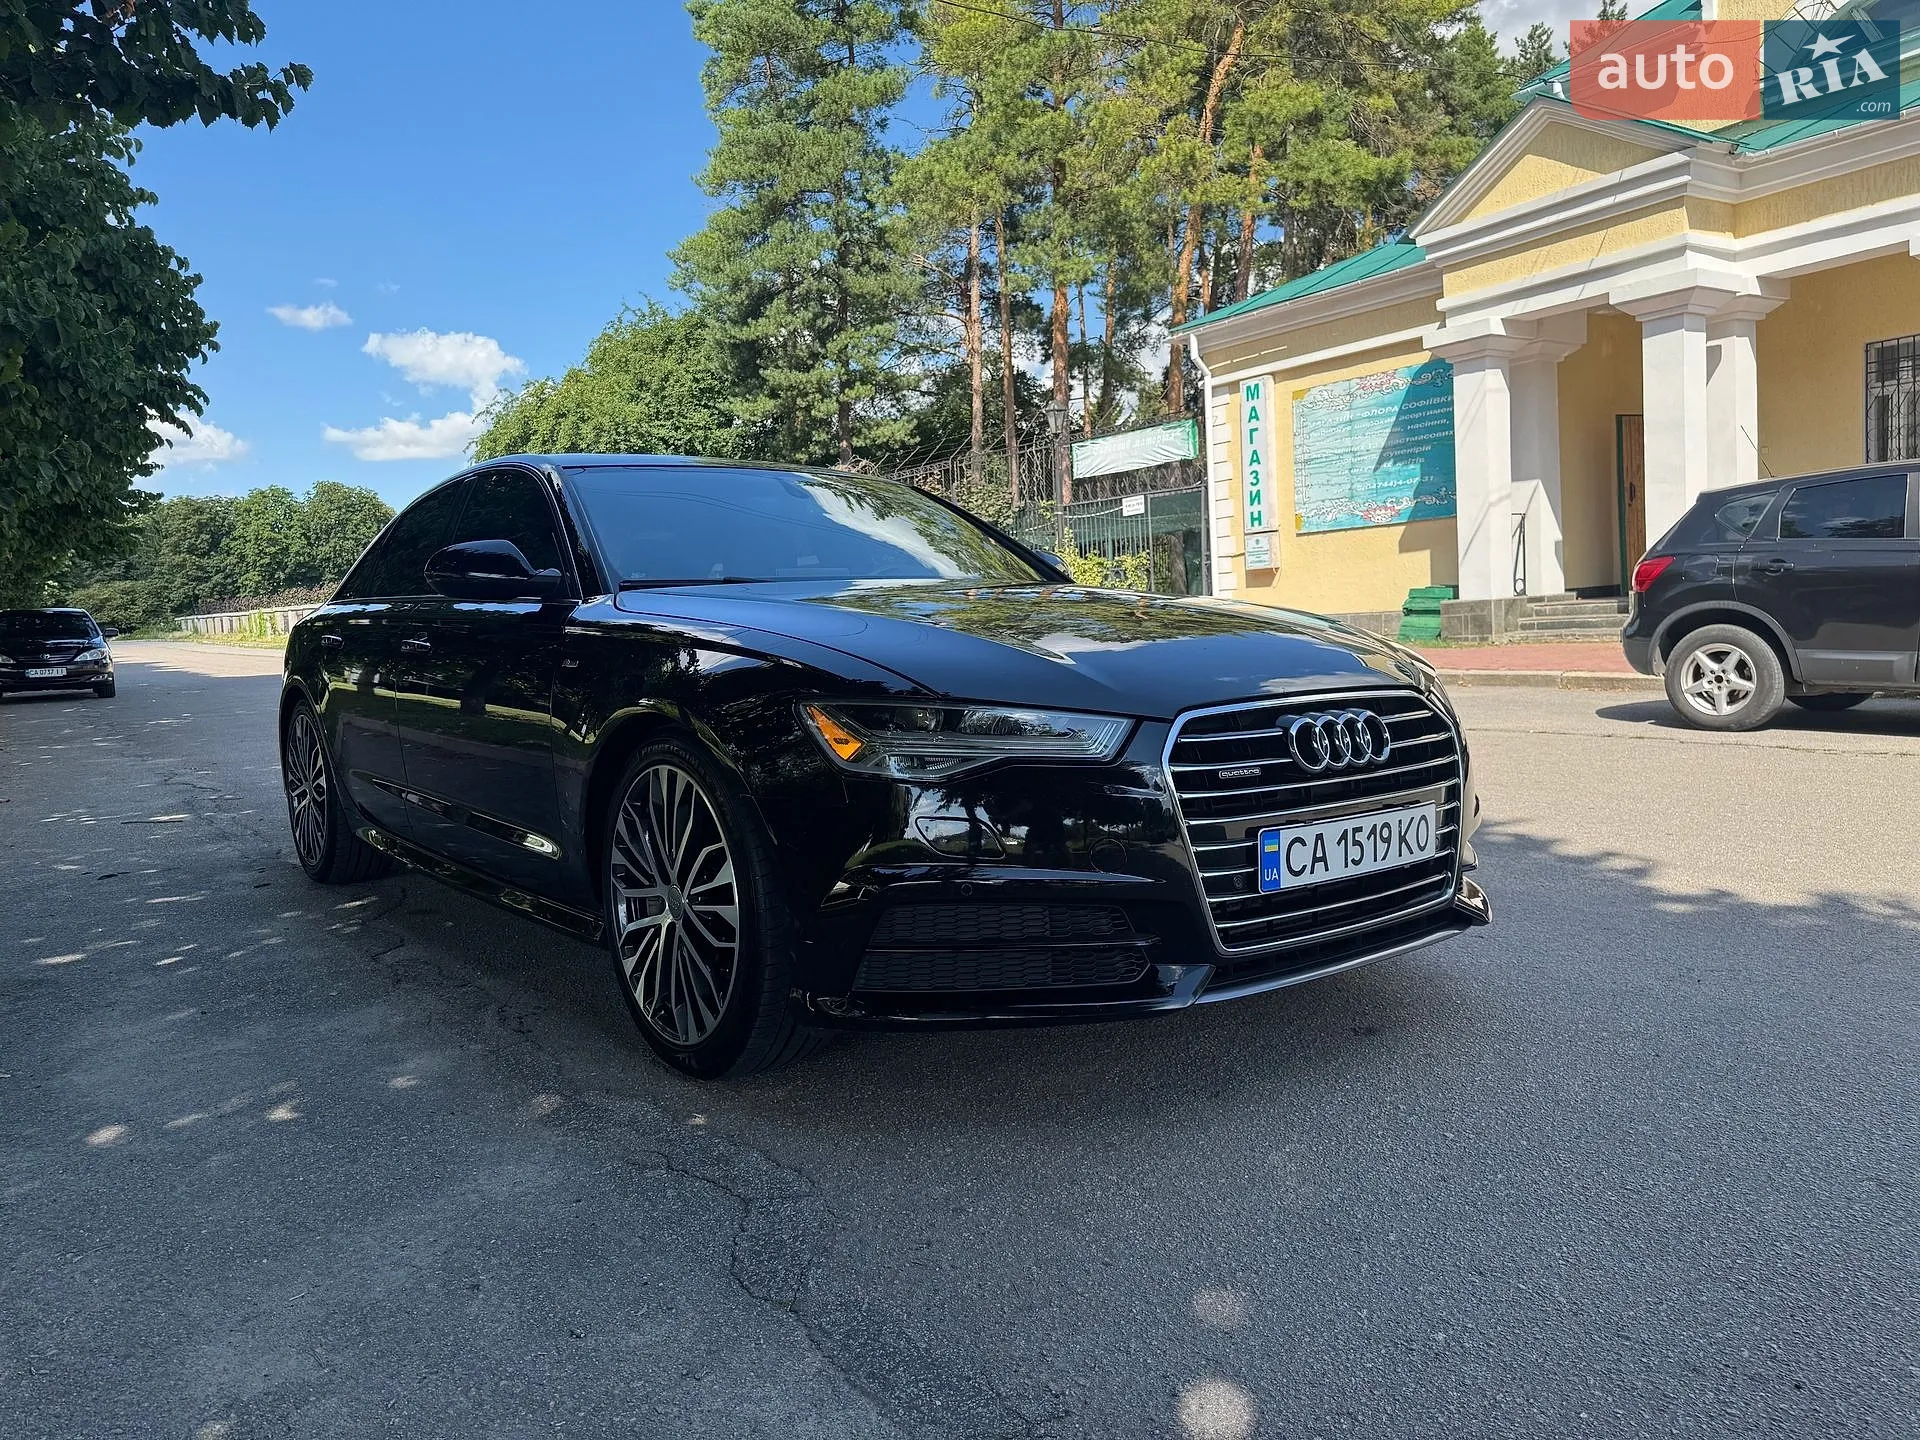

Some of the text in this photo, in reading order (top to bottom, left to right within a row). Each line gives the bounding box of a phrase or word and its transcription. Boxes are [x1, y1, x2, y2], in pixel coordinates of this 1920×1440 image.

[1245, 382, 1263, 528] МАГАЗИН
[1221, 768, 1260, 778] quattro
[1285, 814, 1429, 877] CA 1519 KO
[1264, 868, 1279, 881] UA
